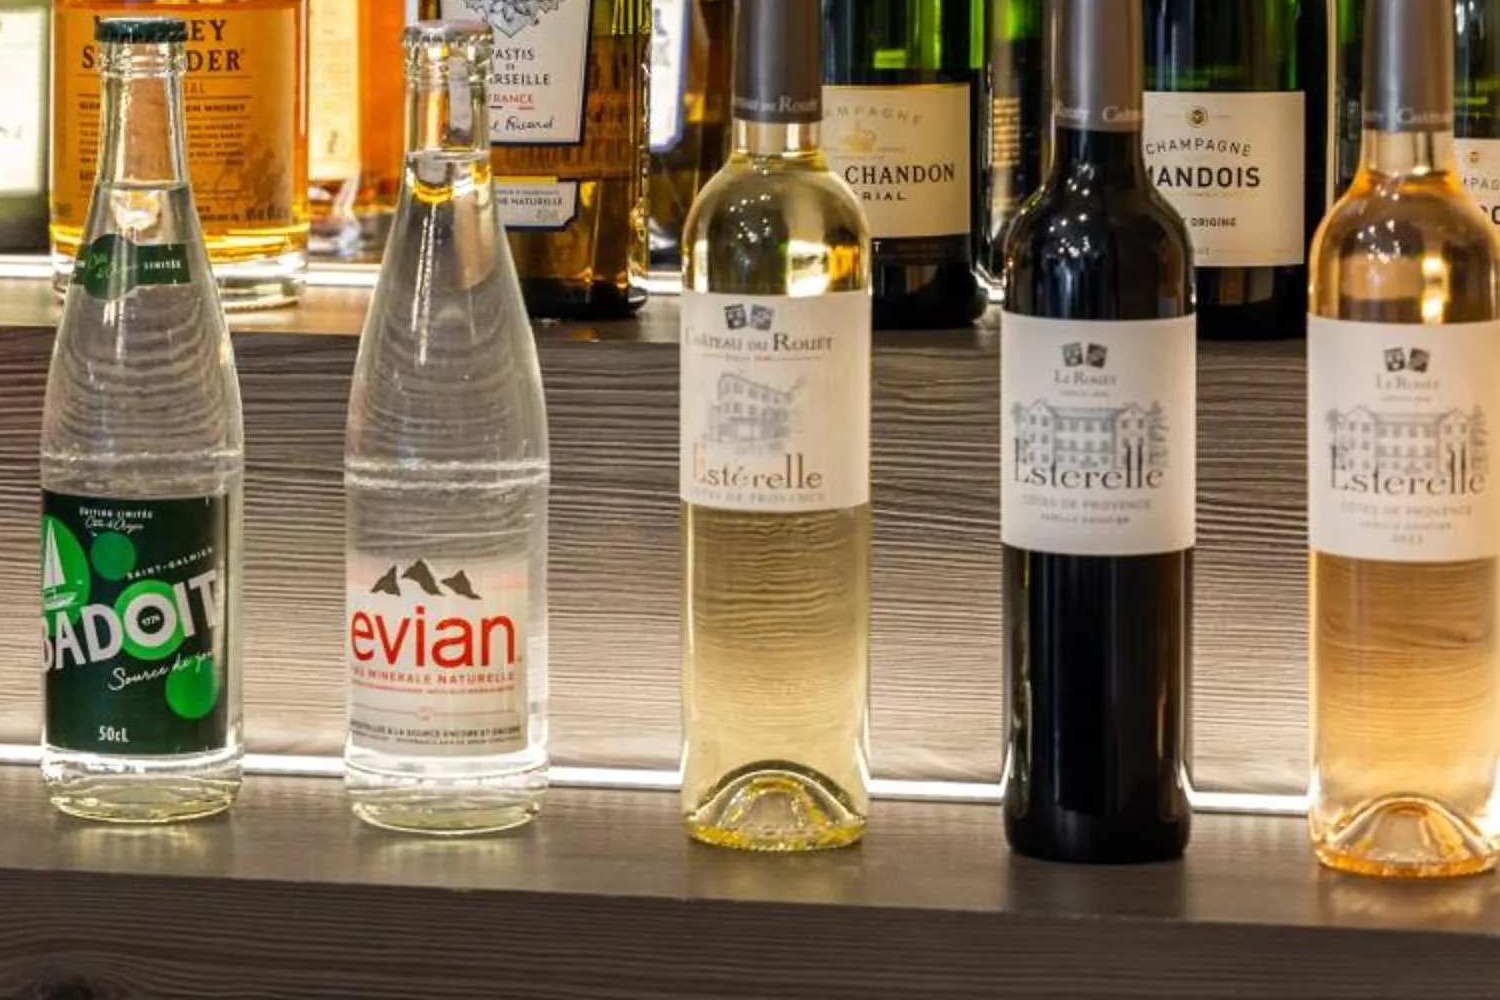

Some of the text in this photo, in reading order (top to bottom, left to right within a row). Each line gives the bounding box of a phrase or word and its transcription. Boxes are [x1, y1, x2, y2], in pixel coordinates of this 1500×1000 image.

[1146, 137, 1252, 157] CHAMPAGNE
[845, 163, 956, 185] CHANDON
[351, 605, 516, 669] evian
[107, 665, 169, 692] Source
[436, 672, 516, 685] NATURELLE
